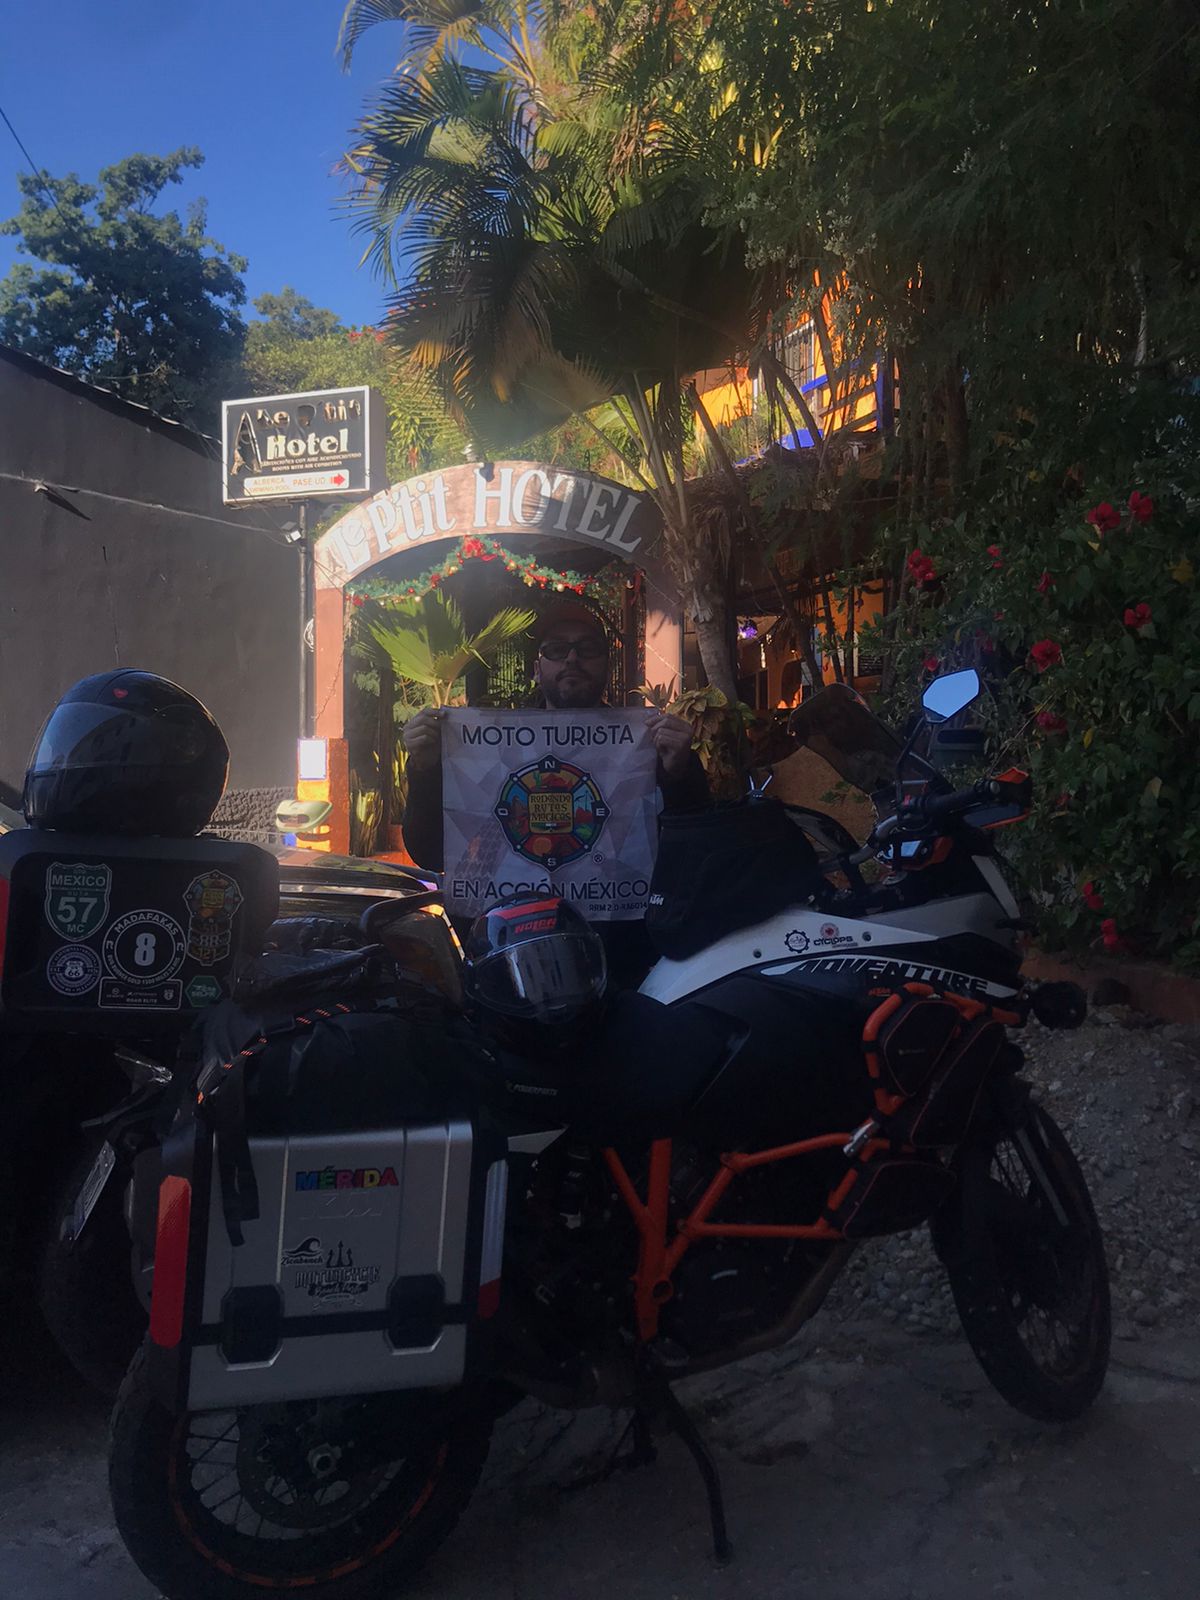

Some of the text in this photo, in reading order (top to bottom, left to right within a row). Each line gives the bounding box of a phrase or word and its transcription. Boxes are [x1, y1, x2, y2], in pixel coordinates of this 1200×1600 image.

[267, 428, 348, 460] Hotel
[292, 477, 313, 486] PASE
[473, 467, 644, 553] HOTEL
[462, 724, 634, 746] MOTO TURISTA
[52, 874, 106, 887] MEXICO
[453, 880, 479, 899] EN
[571, 878, 649, 900] MÉXICO
[56, 896, 98, 924] 57
[66, 924, 85, 933] MC
[114, 912, 180, 936] MADAFAKAS
[134, 932, 157, 967] 8
[813, 935, 854, 946] CYCLOPS
[797, 957, 988, 993] ADVENTURE
[295, 1165, 399, 1192] MÉRIDA
